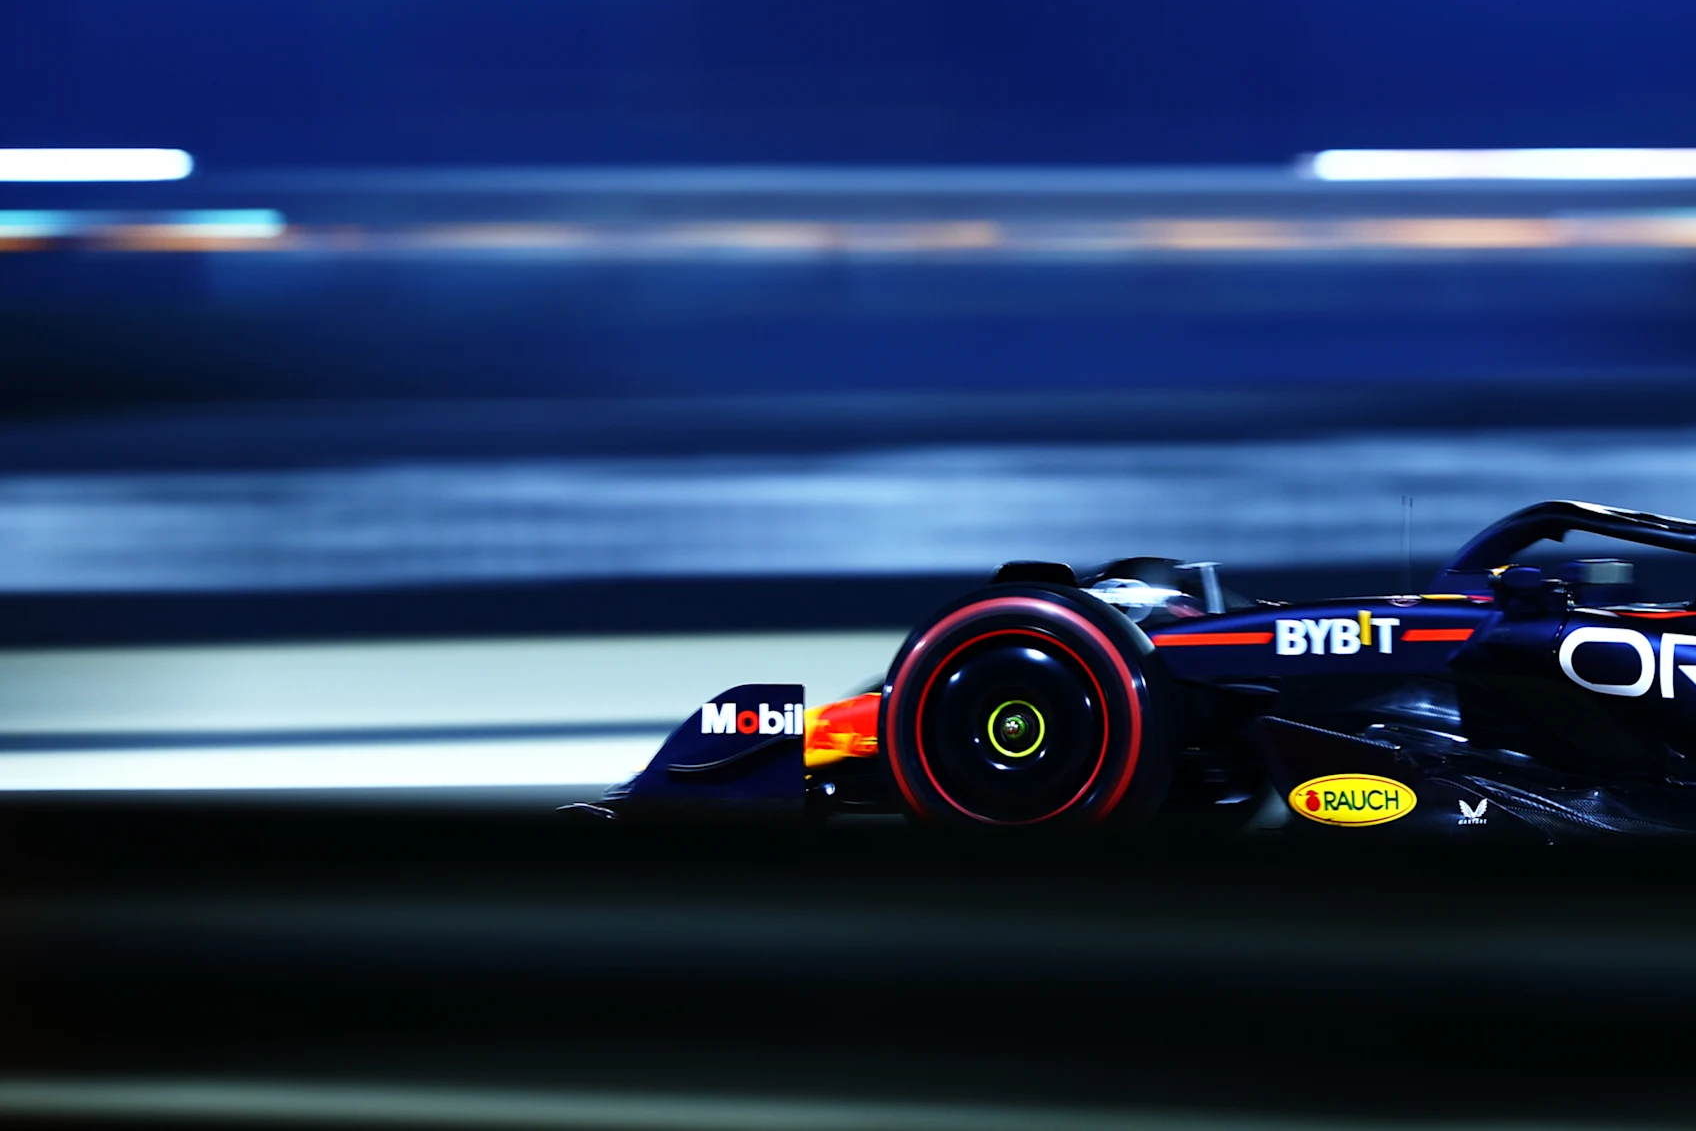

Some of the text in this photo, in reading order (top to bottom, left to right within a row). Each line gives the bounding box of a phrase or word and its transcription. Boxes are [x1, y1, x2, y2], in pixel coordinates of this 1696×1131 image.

[1275, 609, 1400, 656] BYBIT
[701, 702, 804, 735] Mobil
[1323, 789, 1400, 811] RAUCH
